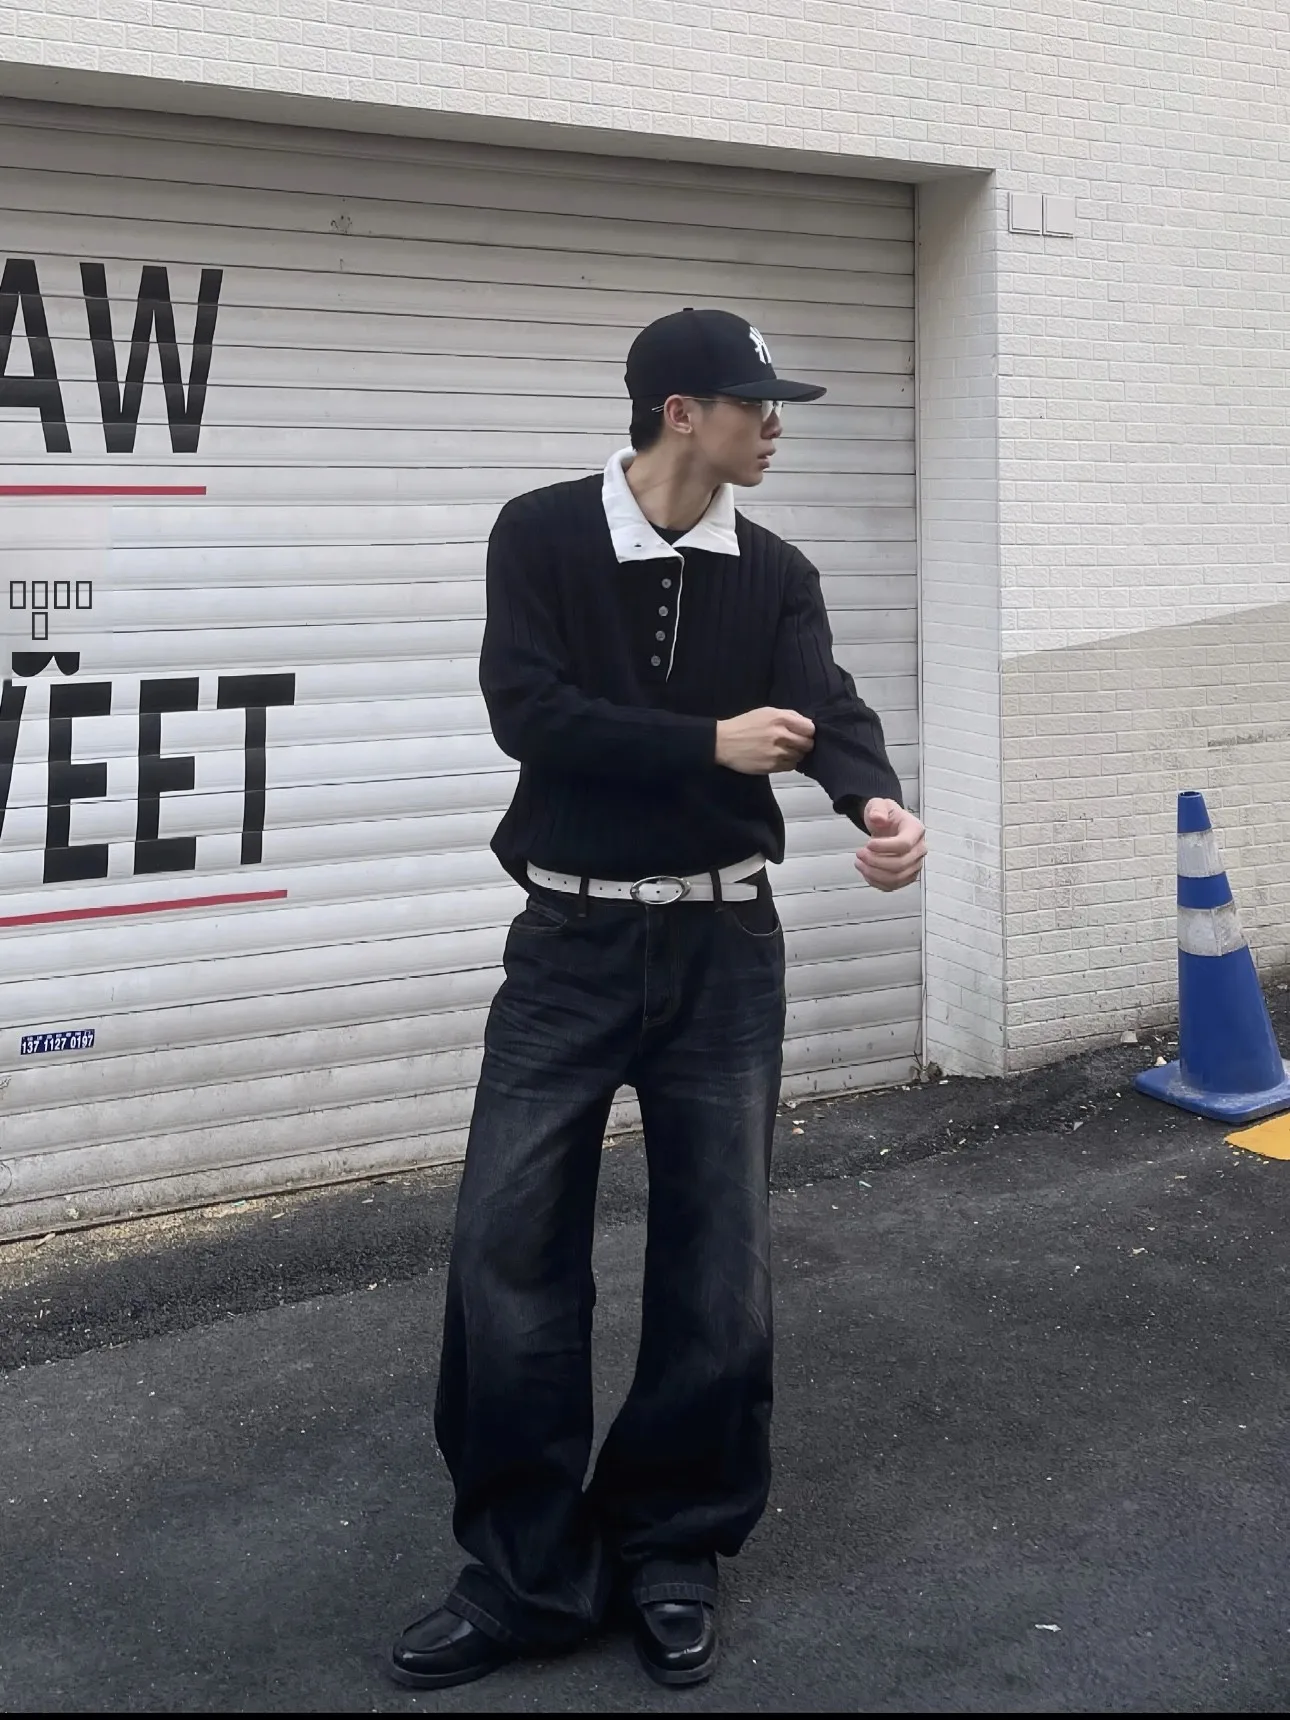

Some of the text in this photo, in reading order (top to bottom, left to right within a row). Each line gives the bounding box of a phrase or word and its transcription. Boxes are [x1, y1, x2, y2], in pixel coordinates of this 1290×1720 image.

[0, 673, 296, 884] EET
[22, 1040, 39, 1054] 137
[44, 1037, 66, 1052] 1127
